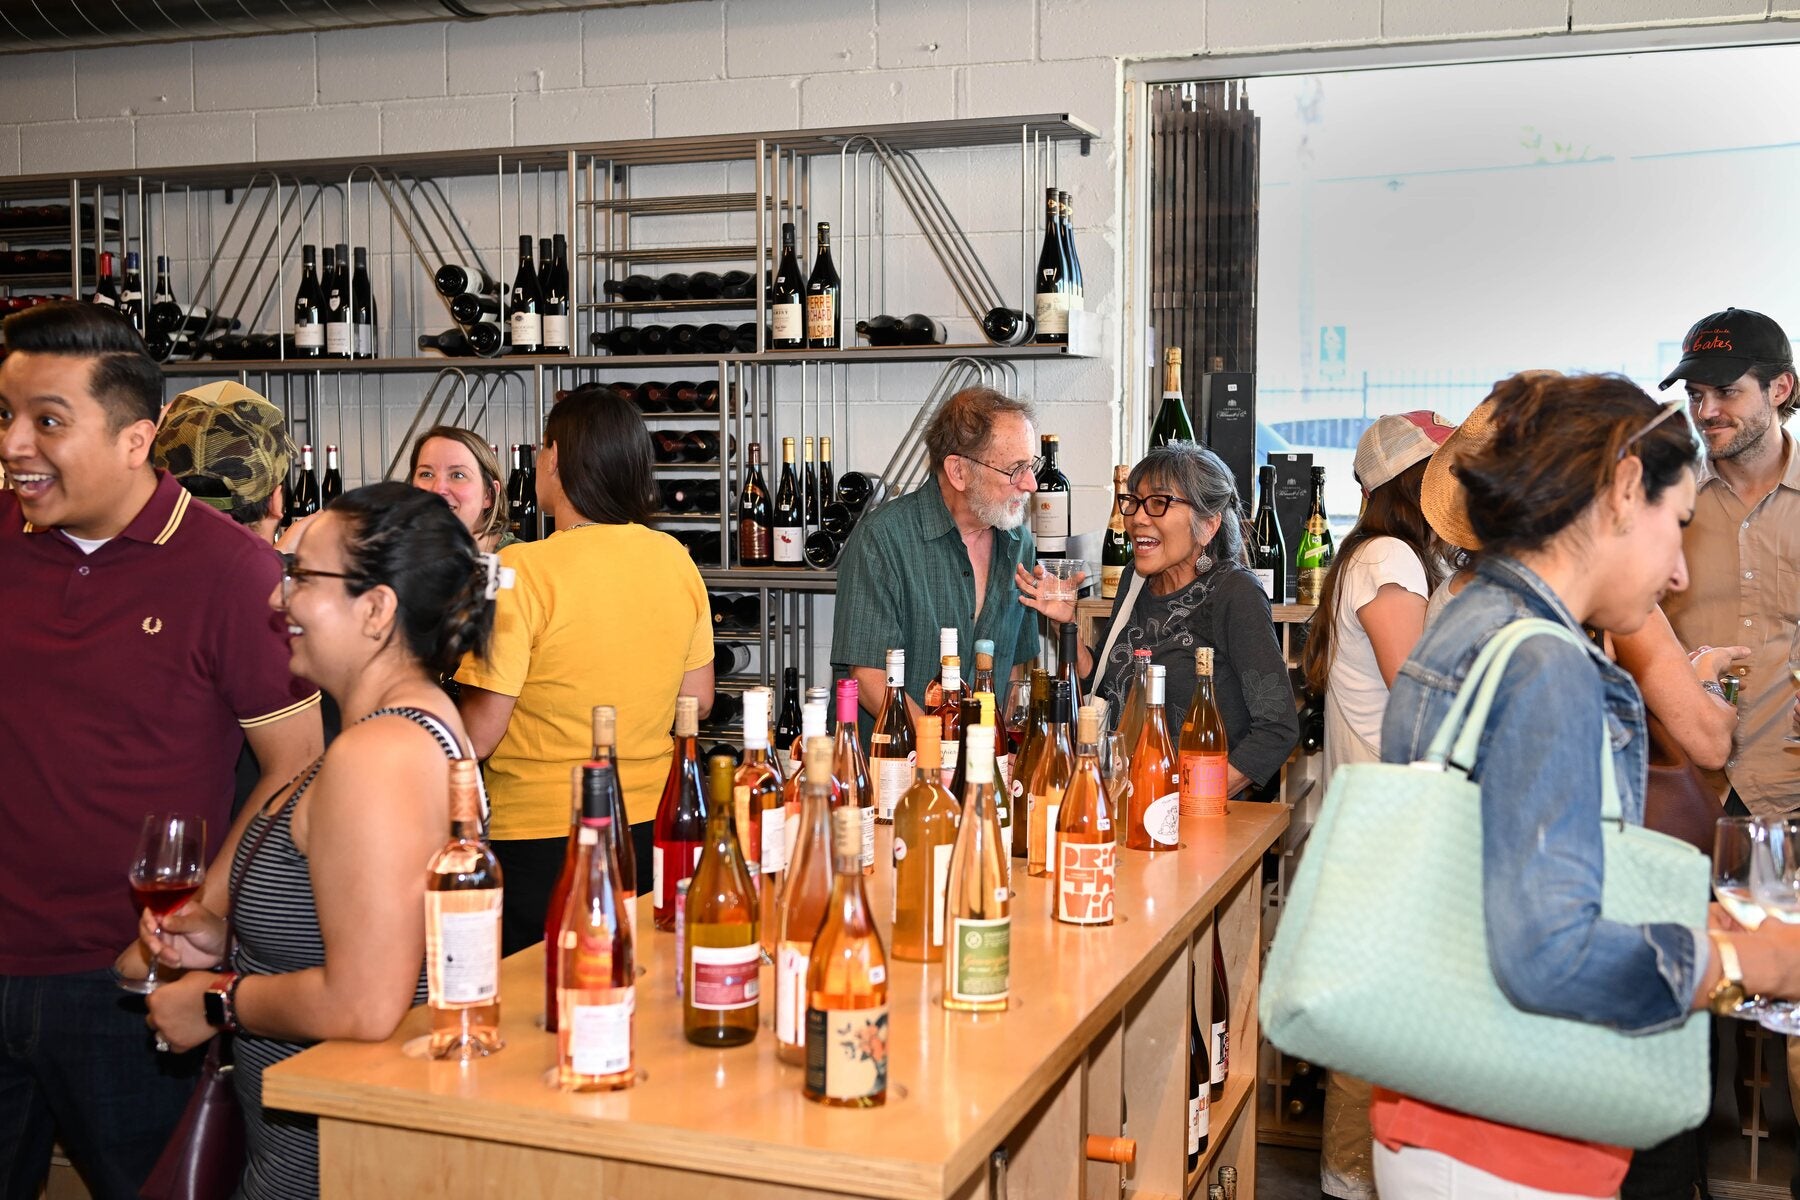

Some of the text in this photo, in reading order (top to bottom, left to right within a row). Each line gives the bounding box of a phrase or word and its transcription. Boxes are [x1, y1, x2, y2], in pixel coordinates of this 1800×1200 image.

[1693, 335, 1733, 352] Gates
[1064, 846, 1117, 868] DRin
[1064, 868, 1114, 892] Th
[1063, 891, 1115, 918] Win
